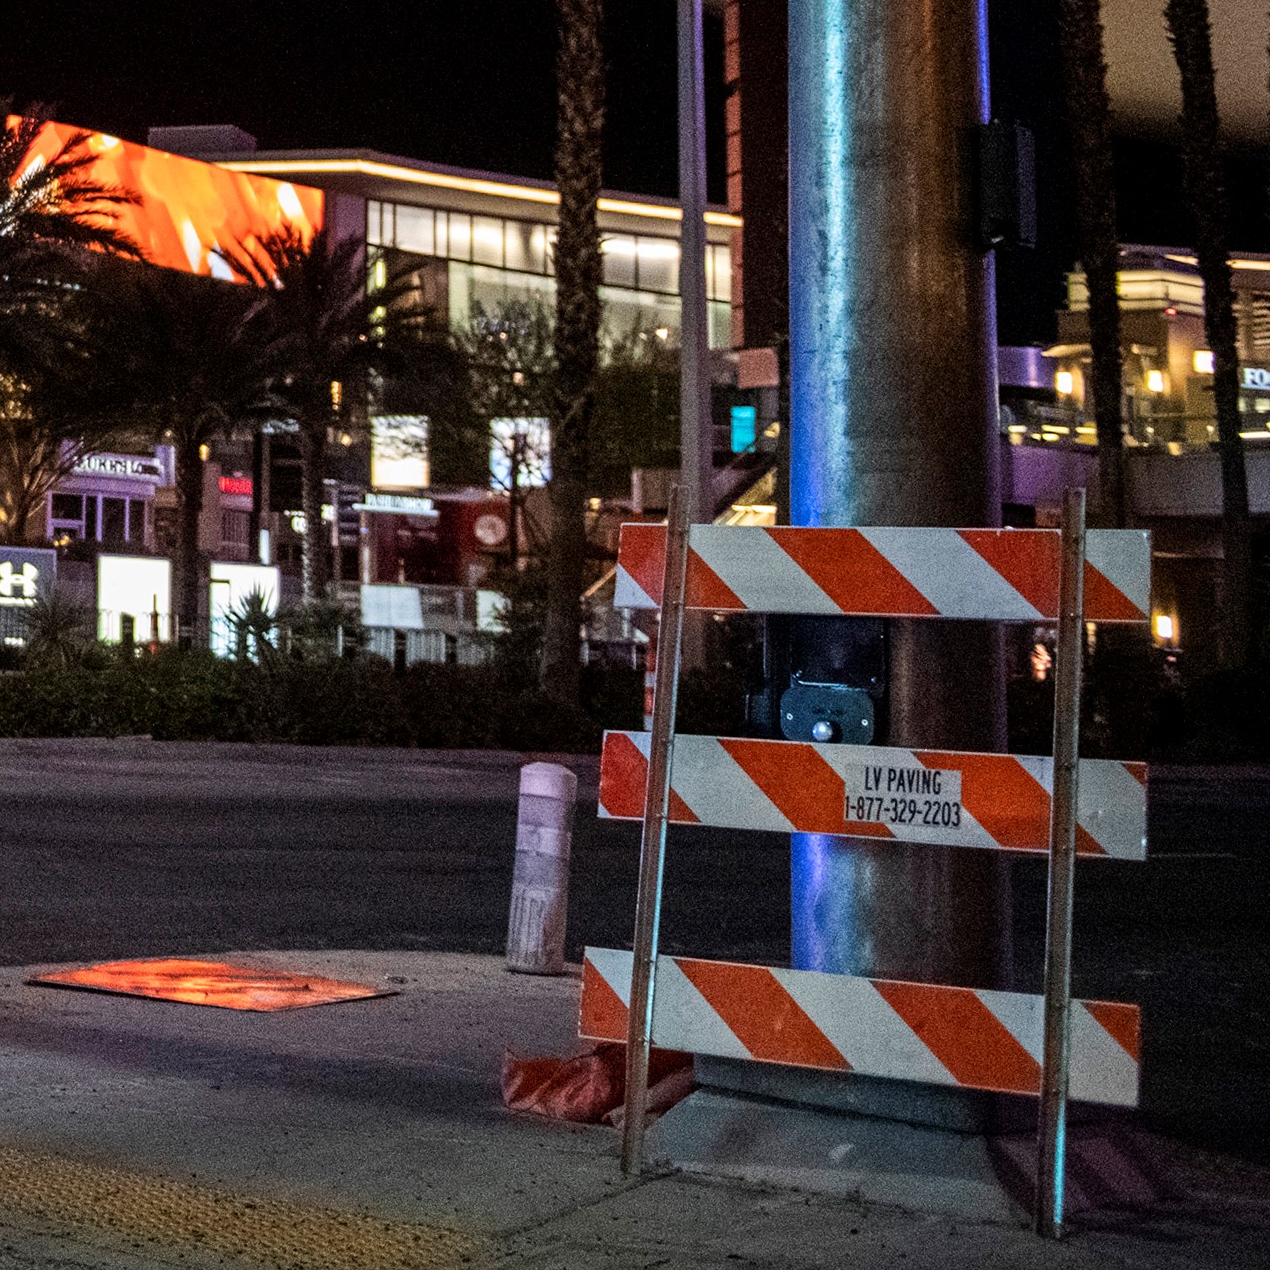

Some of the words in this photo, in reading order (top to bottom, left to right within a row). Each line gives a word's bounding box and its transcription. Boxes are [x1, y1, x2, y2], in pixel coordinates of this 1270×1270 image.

[864, 766, 882, 791] LV
[887, 768, 942, 795] PAVING
[845, 795, 961, 827] 1-877-329-2203
